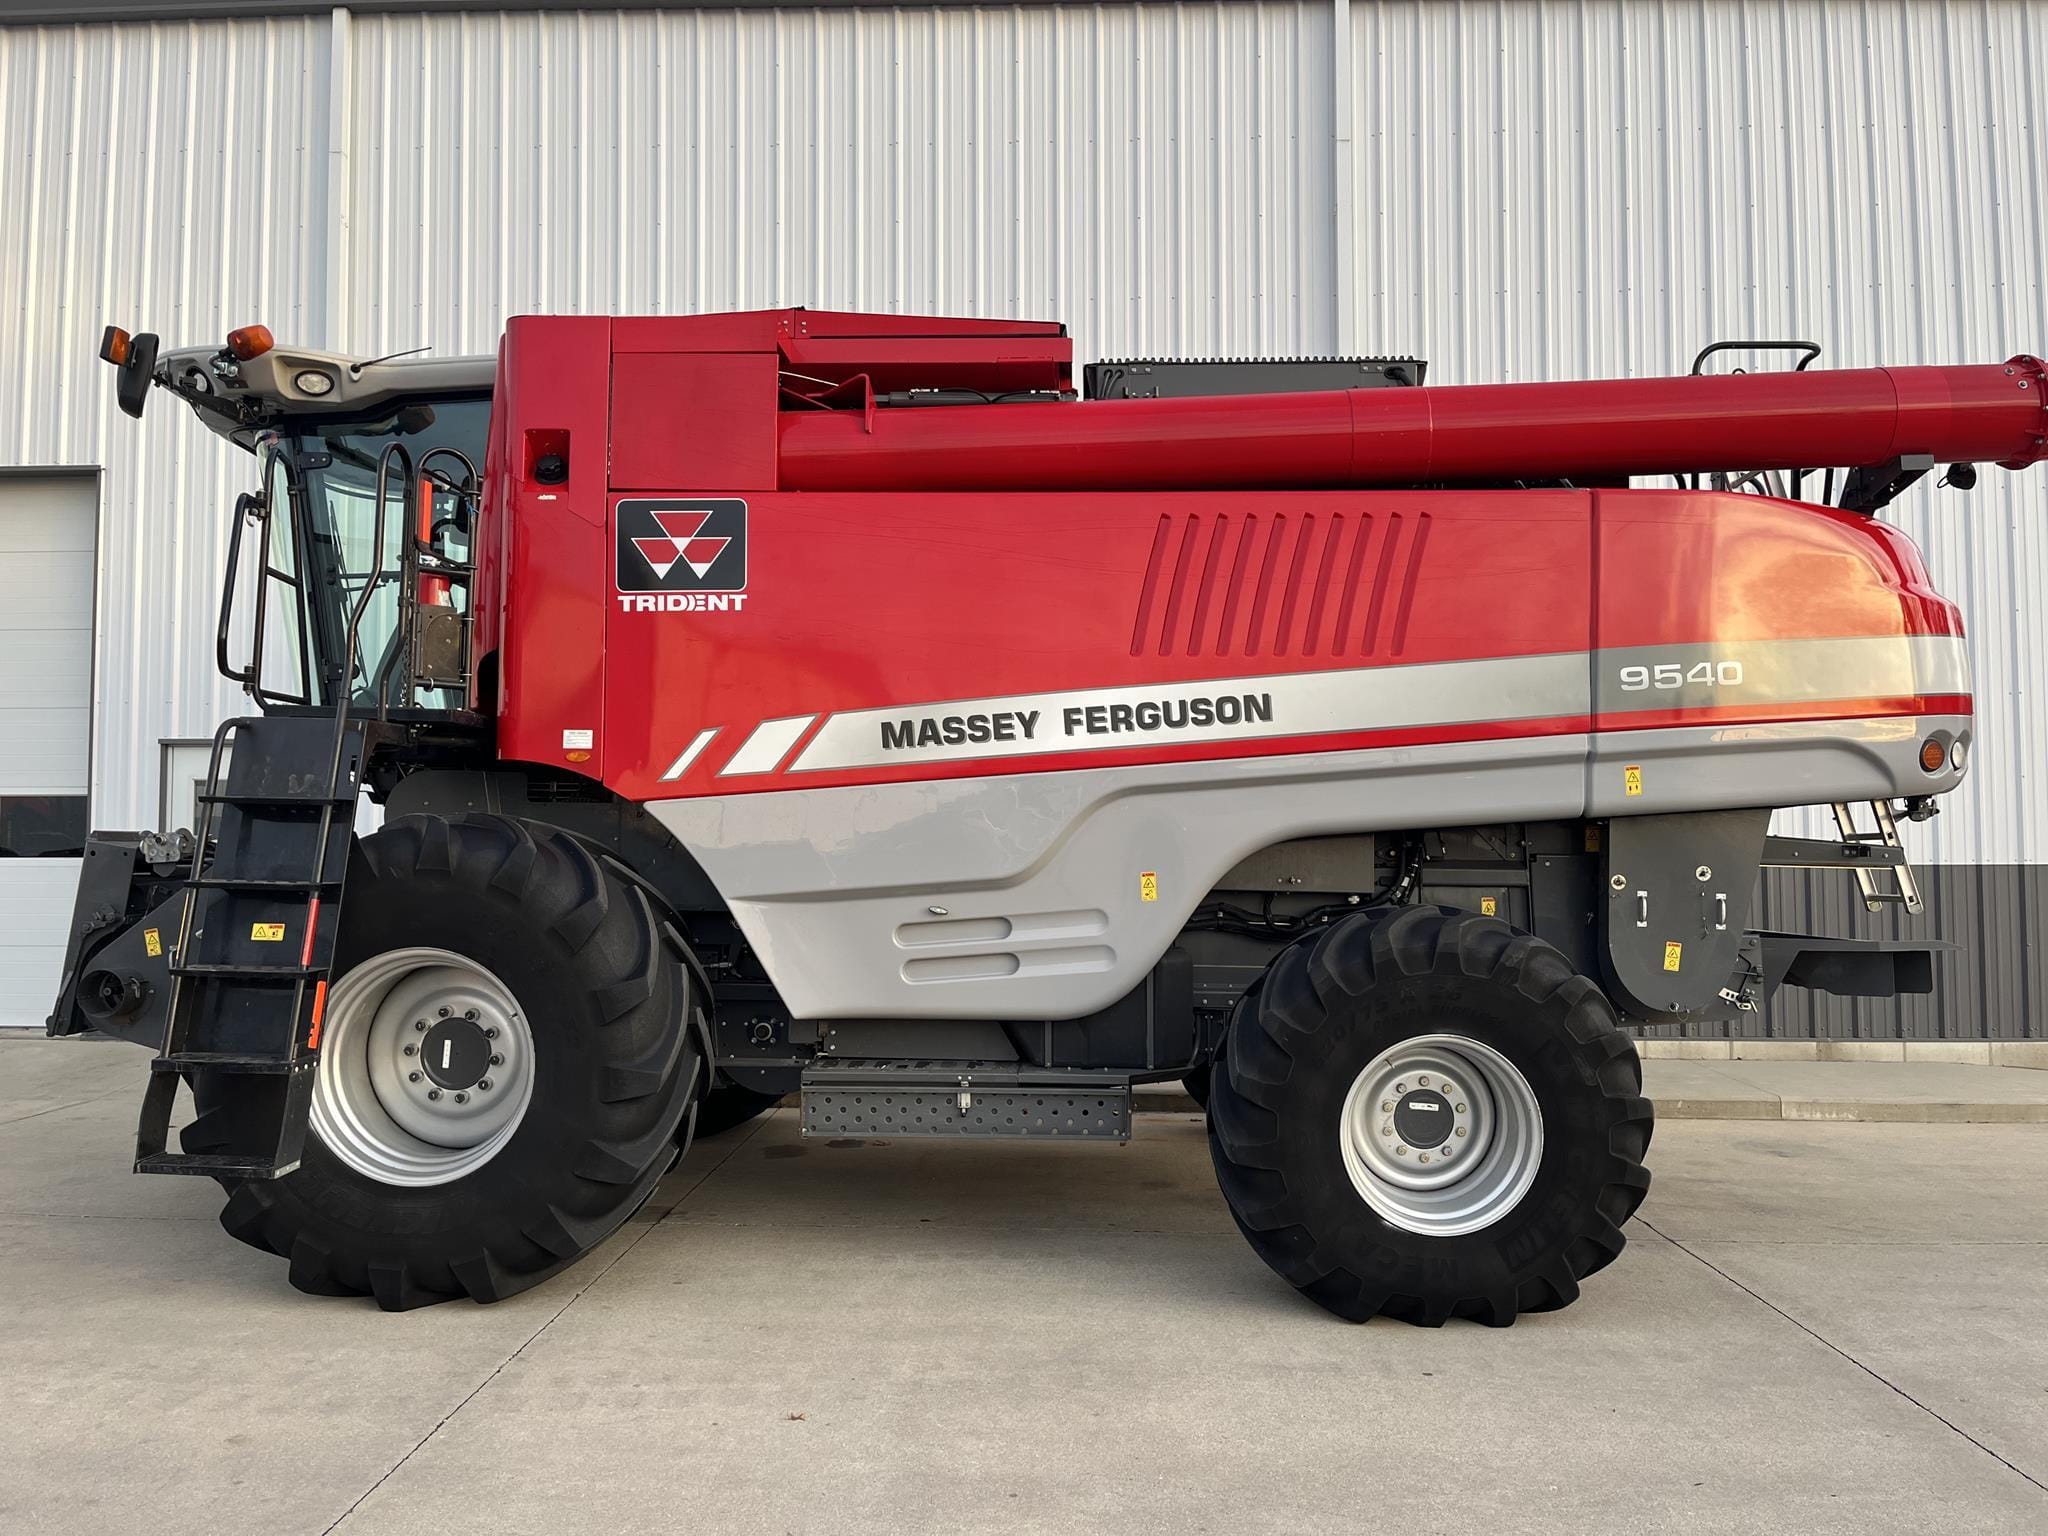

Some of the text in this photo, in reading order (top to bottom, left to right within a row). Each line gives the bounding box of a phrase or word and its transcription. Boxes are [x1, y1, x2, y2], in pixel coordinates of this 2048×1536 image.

[617, 594, 747, 612] TRIDENT
[1620, 661, 1743, 691] 9540
[881, 693, 1273, 750] MASSEY FERGUSON
